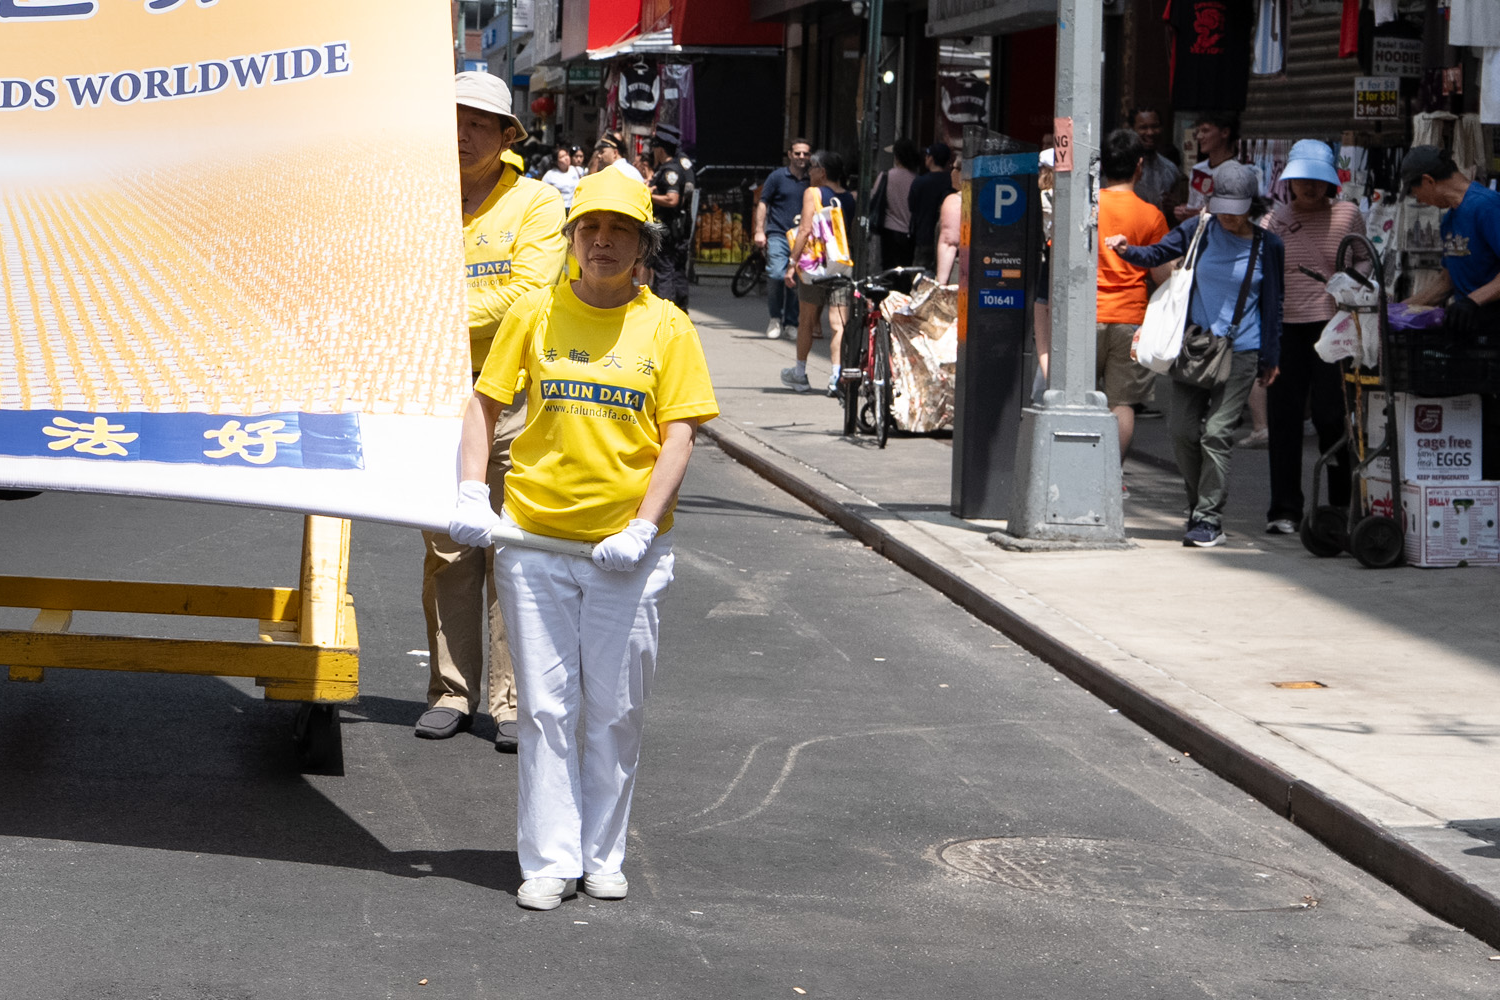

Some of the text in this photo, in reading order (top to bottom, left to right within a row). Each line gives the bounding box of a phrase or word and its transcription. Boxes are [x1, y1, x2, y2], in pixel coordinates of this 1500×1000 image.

[1375, 50, 1421, 64] HOODIE
[65, 41, 352, 107] WORLDWIDE
[1367, 79, 1380, 89] for
[1358, 91, 1364, 101] 2
[1365, 91, 1378, 101] for
[1358, 104, 1364, 115] 3
[1366, 103, 1379, 115] for
[994, 183, 1018, 219] P
[991, 256, 1022, 265] ParkNYC
[477, 262, 510, 275] DAFA
[983, 295, 1015, 306] 101641
[538, 347, 655, 376] 法輪大法
[542, 382, 640, 407] FALUN DAFA
[544, 404, 638, 425] www.falundafa.org
[1417, 435, 1472, 451] cage free
[1436, 452, 1472, 467] EGGS
[1428, 497, 1451, 507] BALLY
